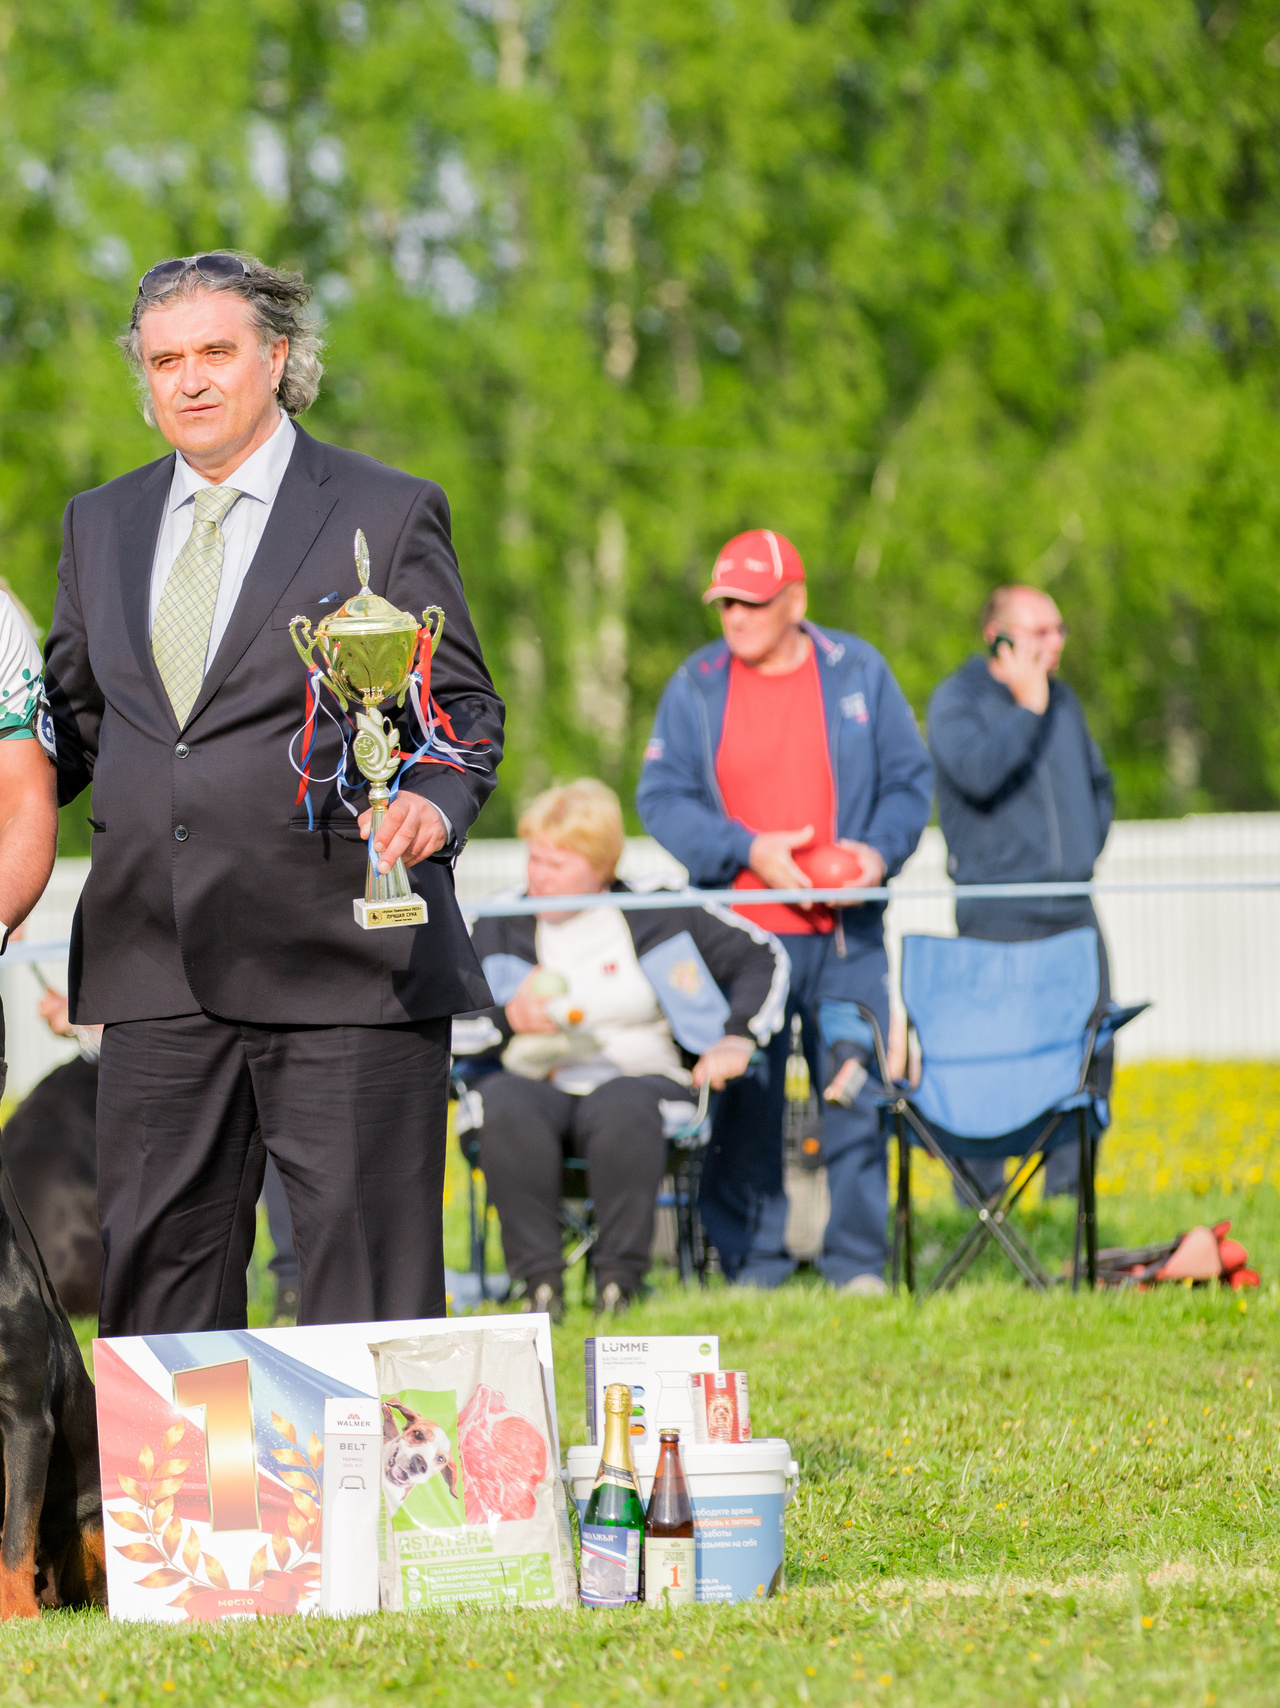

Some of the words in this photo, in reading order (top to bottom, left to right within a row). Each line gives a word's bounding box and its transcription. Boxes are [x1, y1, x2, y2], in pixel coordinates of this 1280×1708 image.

[171, 1356, 262, 1532] 1
[339, 1442, 367, 1451] BELT
[731, 1508, 754, 1516] время
[703, 1529, 732, 1538] заботы
[742, 1538, 758, 1547] себя
[446, 1572, 485, 1581] ВЗРОСЛЫХ
[670, 1563, 681, 1588] 1
[430, 1582, 464, 1590] КРУПНЫХ
[465, 1579, 490, 1587] ПОРОД
[535, 1587, 541, 1595] 3
[432, 1595, 439, 1603] С
[440, 1591, 493, 1603] ЯГНЕНКОМ
